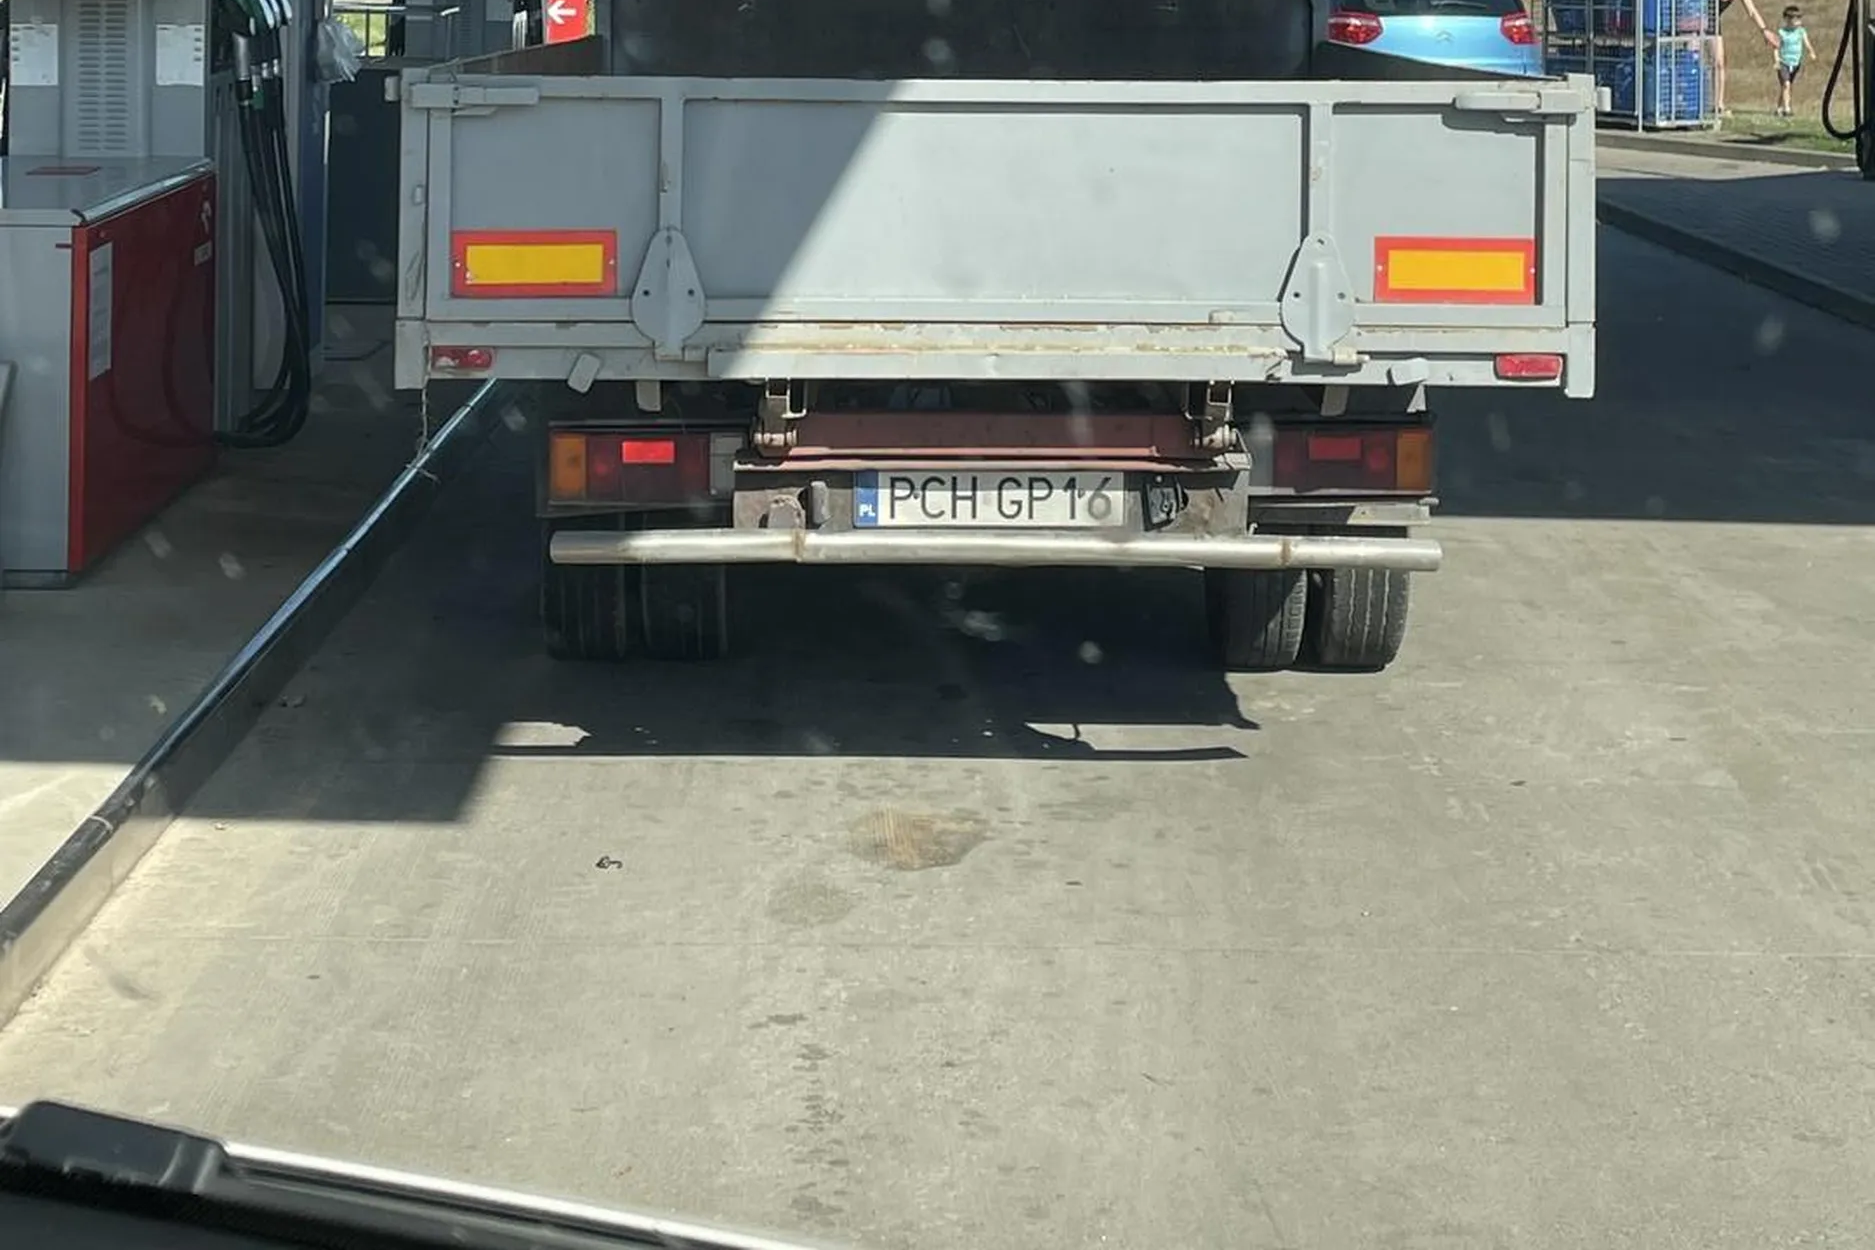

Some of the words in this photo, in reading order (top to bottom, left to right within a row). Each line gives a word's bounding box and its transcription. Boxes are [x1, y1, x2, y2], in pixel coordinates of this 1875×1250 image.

[860, 503, 876, 517] PL
[889, 475, 977, 519] PCH
[997, 475, 1113, 520] GP16
